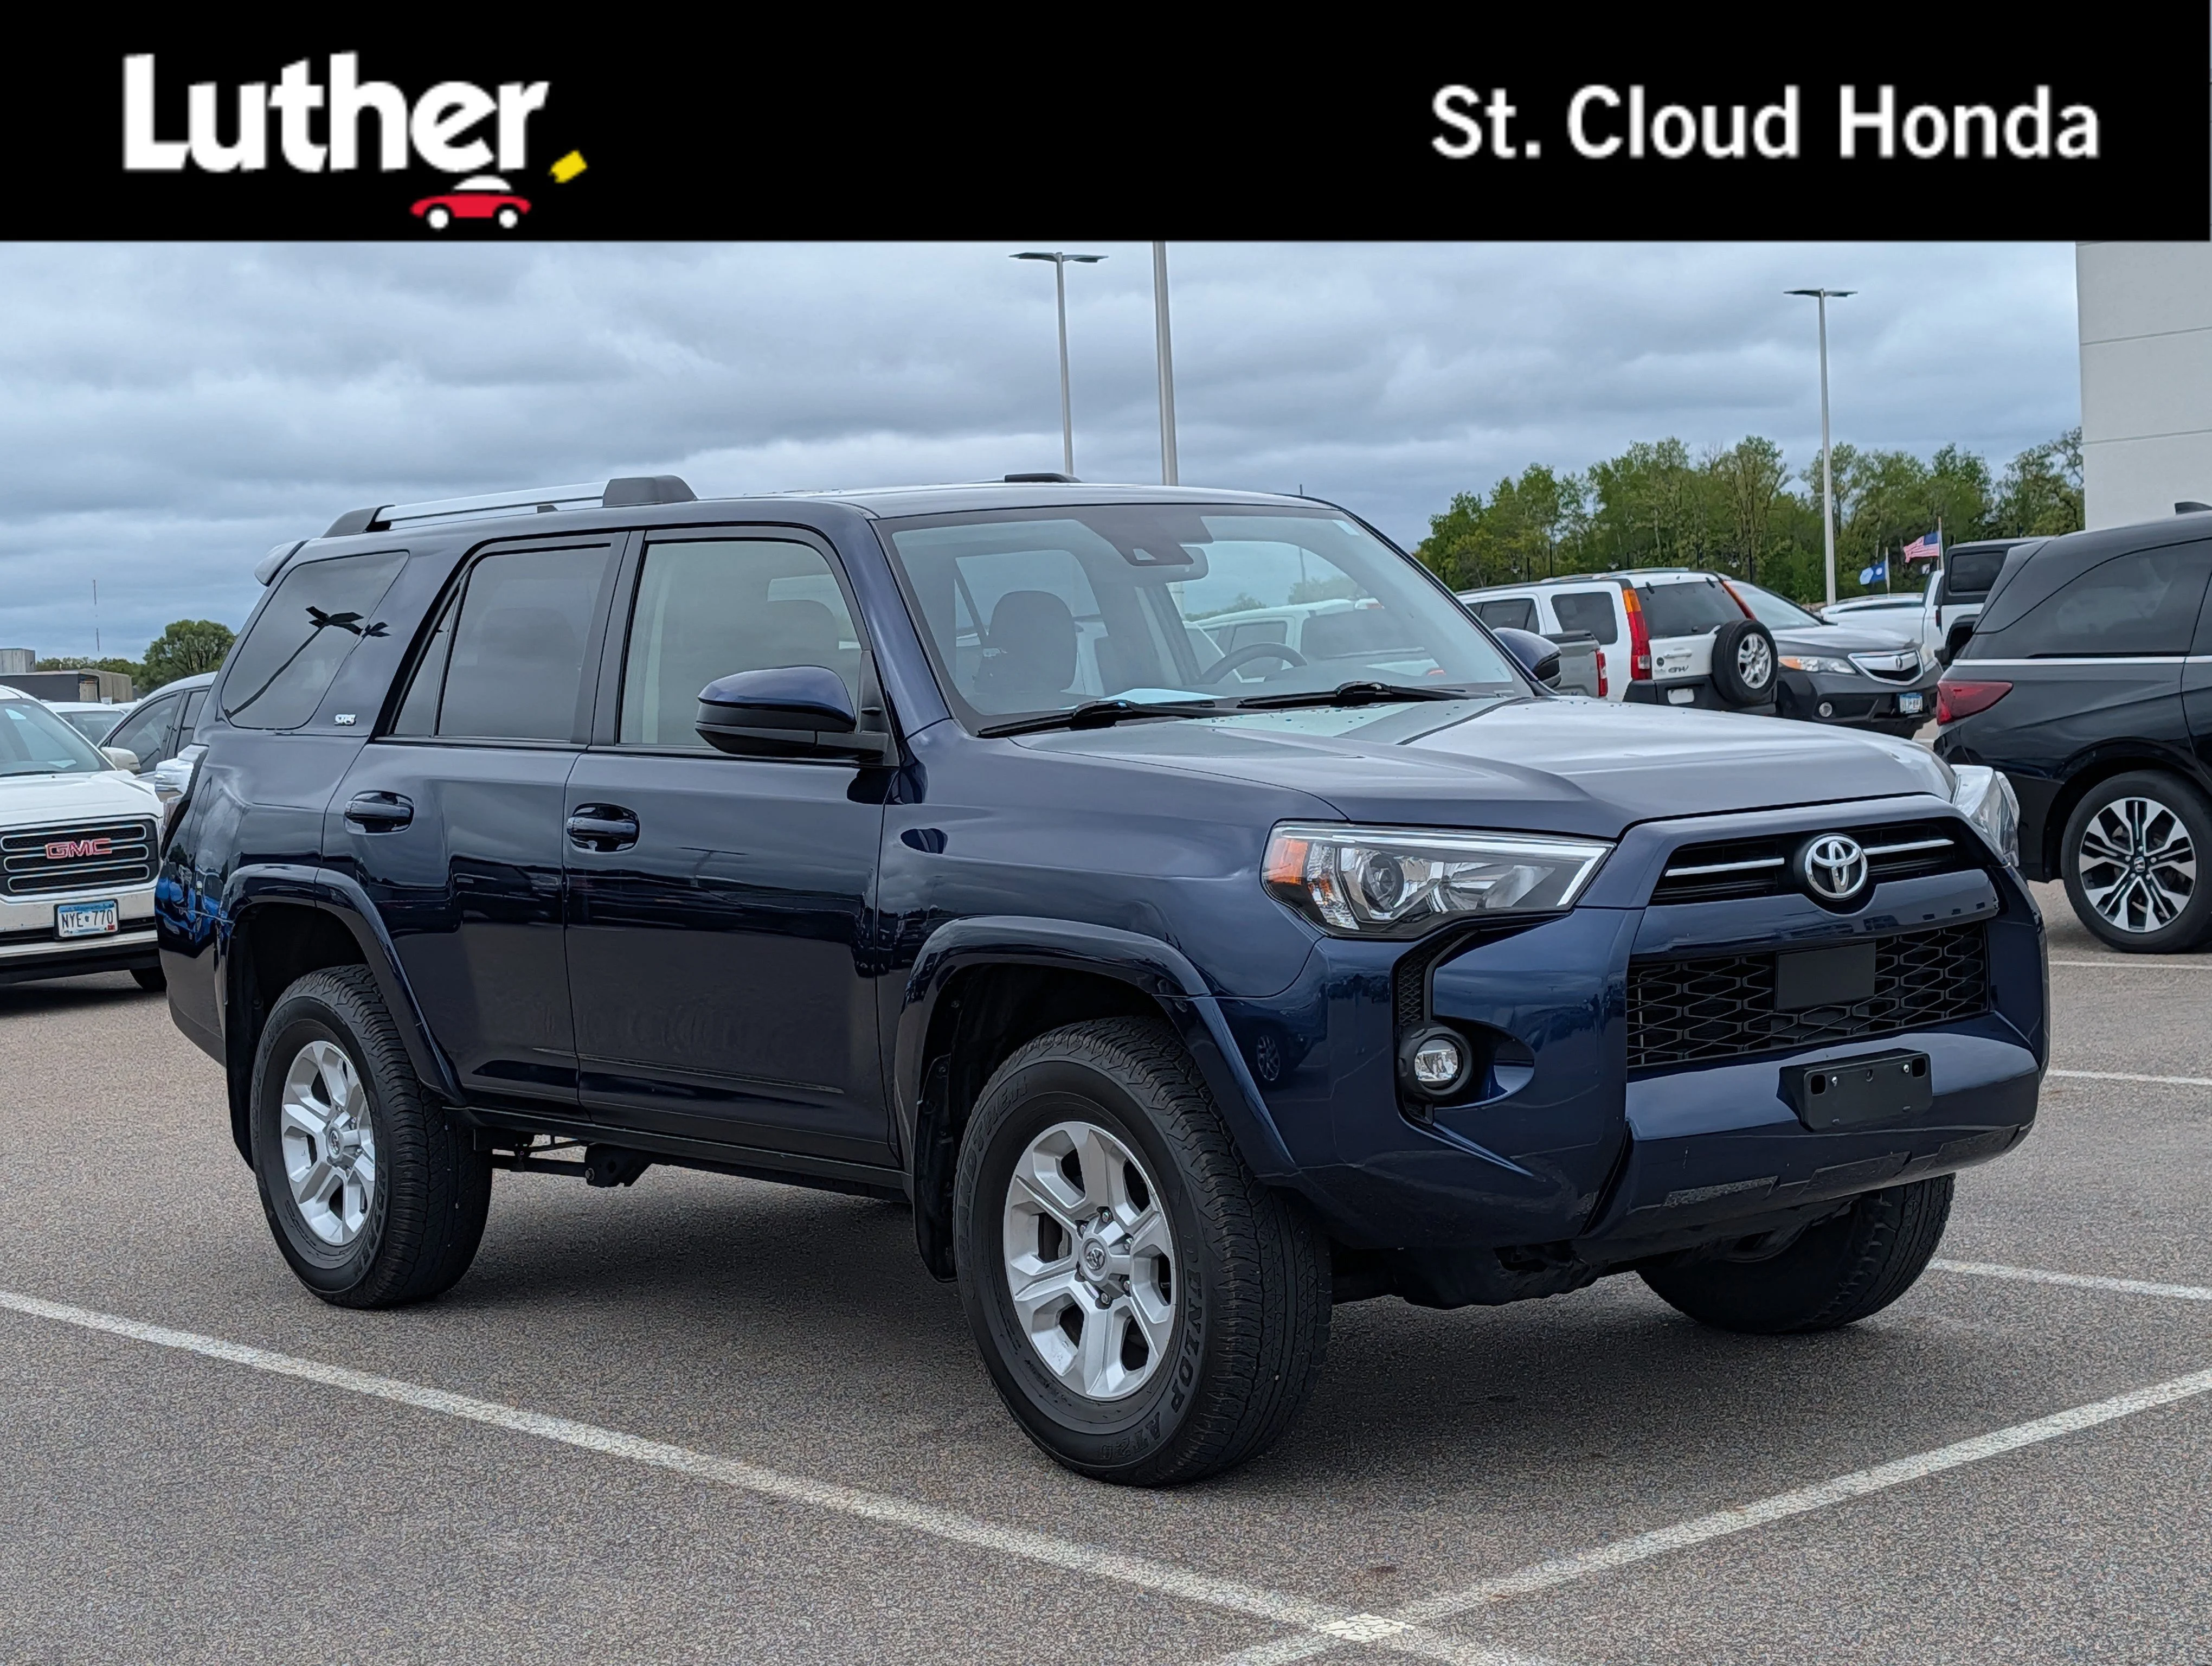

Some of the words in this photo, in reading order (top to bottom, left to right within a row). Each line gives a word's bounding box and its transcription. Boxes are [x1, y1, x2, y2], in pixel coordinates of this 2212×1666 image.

[45, 838, 112, 859] GMC
[61, 911, 84, 930] NYE
[92, 909, 113, 926] 770
